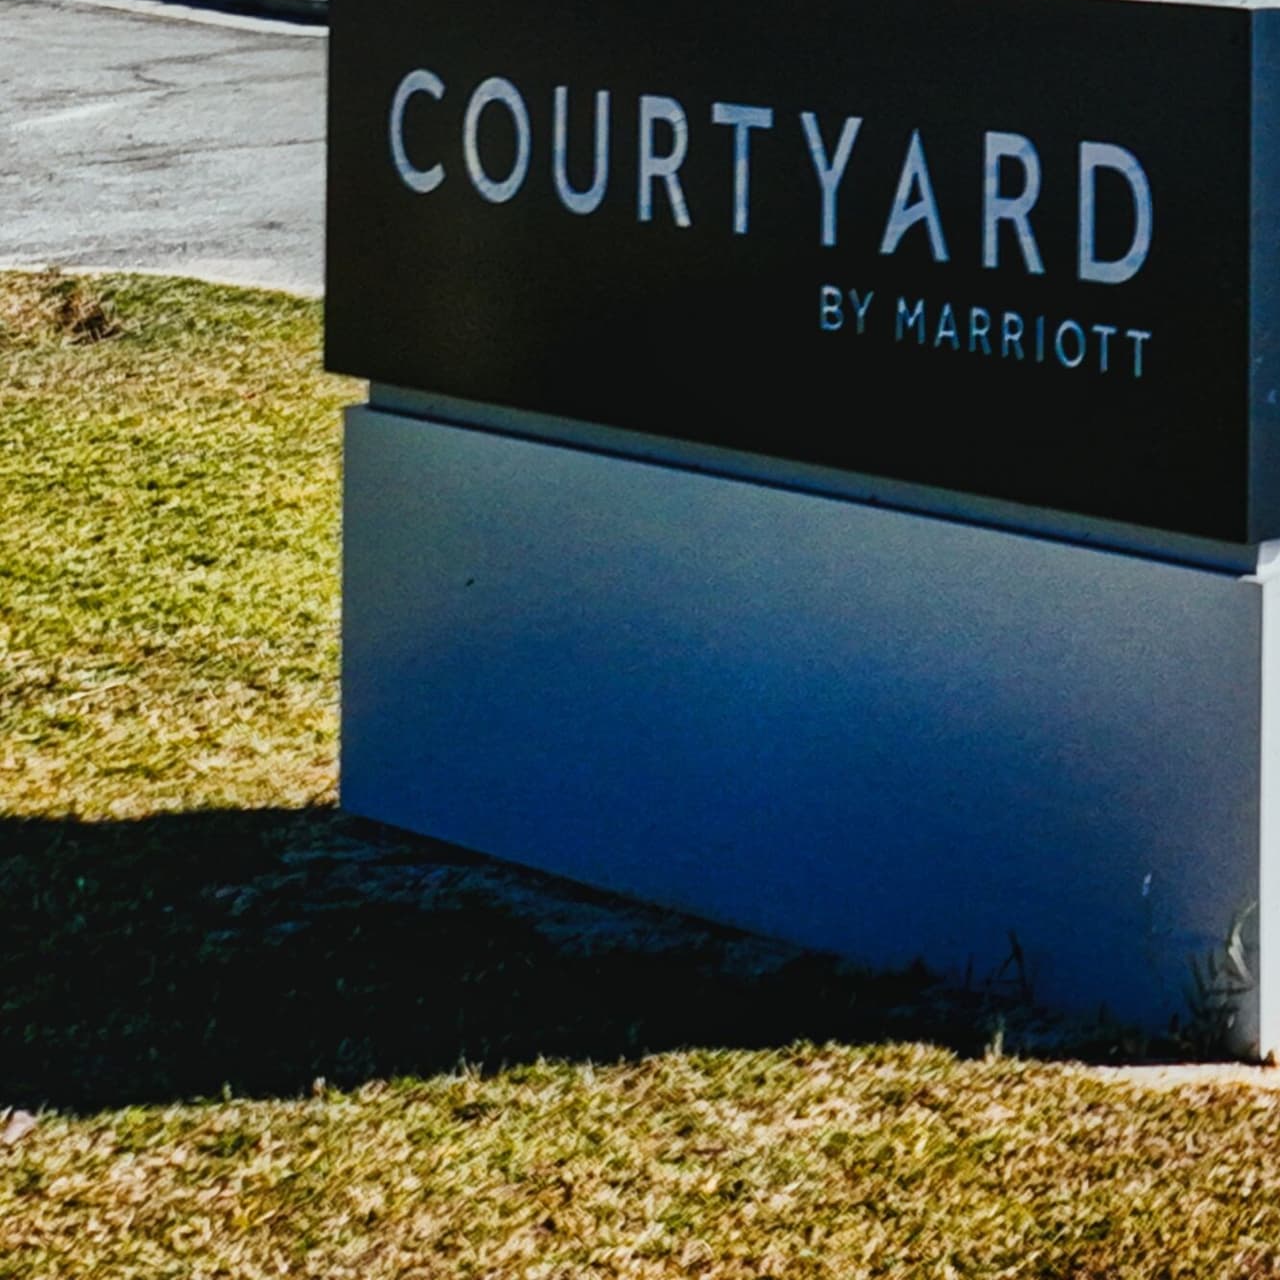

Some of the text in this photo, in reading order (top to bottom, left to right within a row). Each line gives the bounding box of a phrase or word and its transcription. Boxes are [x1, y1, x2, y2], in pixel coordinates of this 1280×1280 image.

[389, 69, 1153, 284] COURTYARD
[821, 284, 1153, 378] BY MARRIOTT
